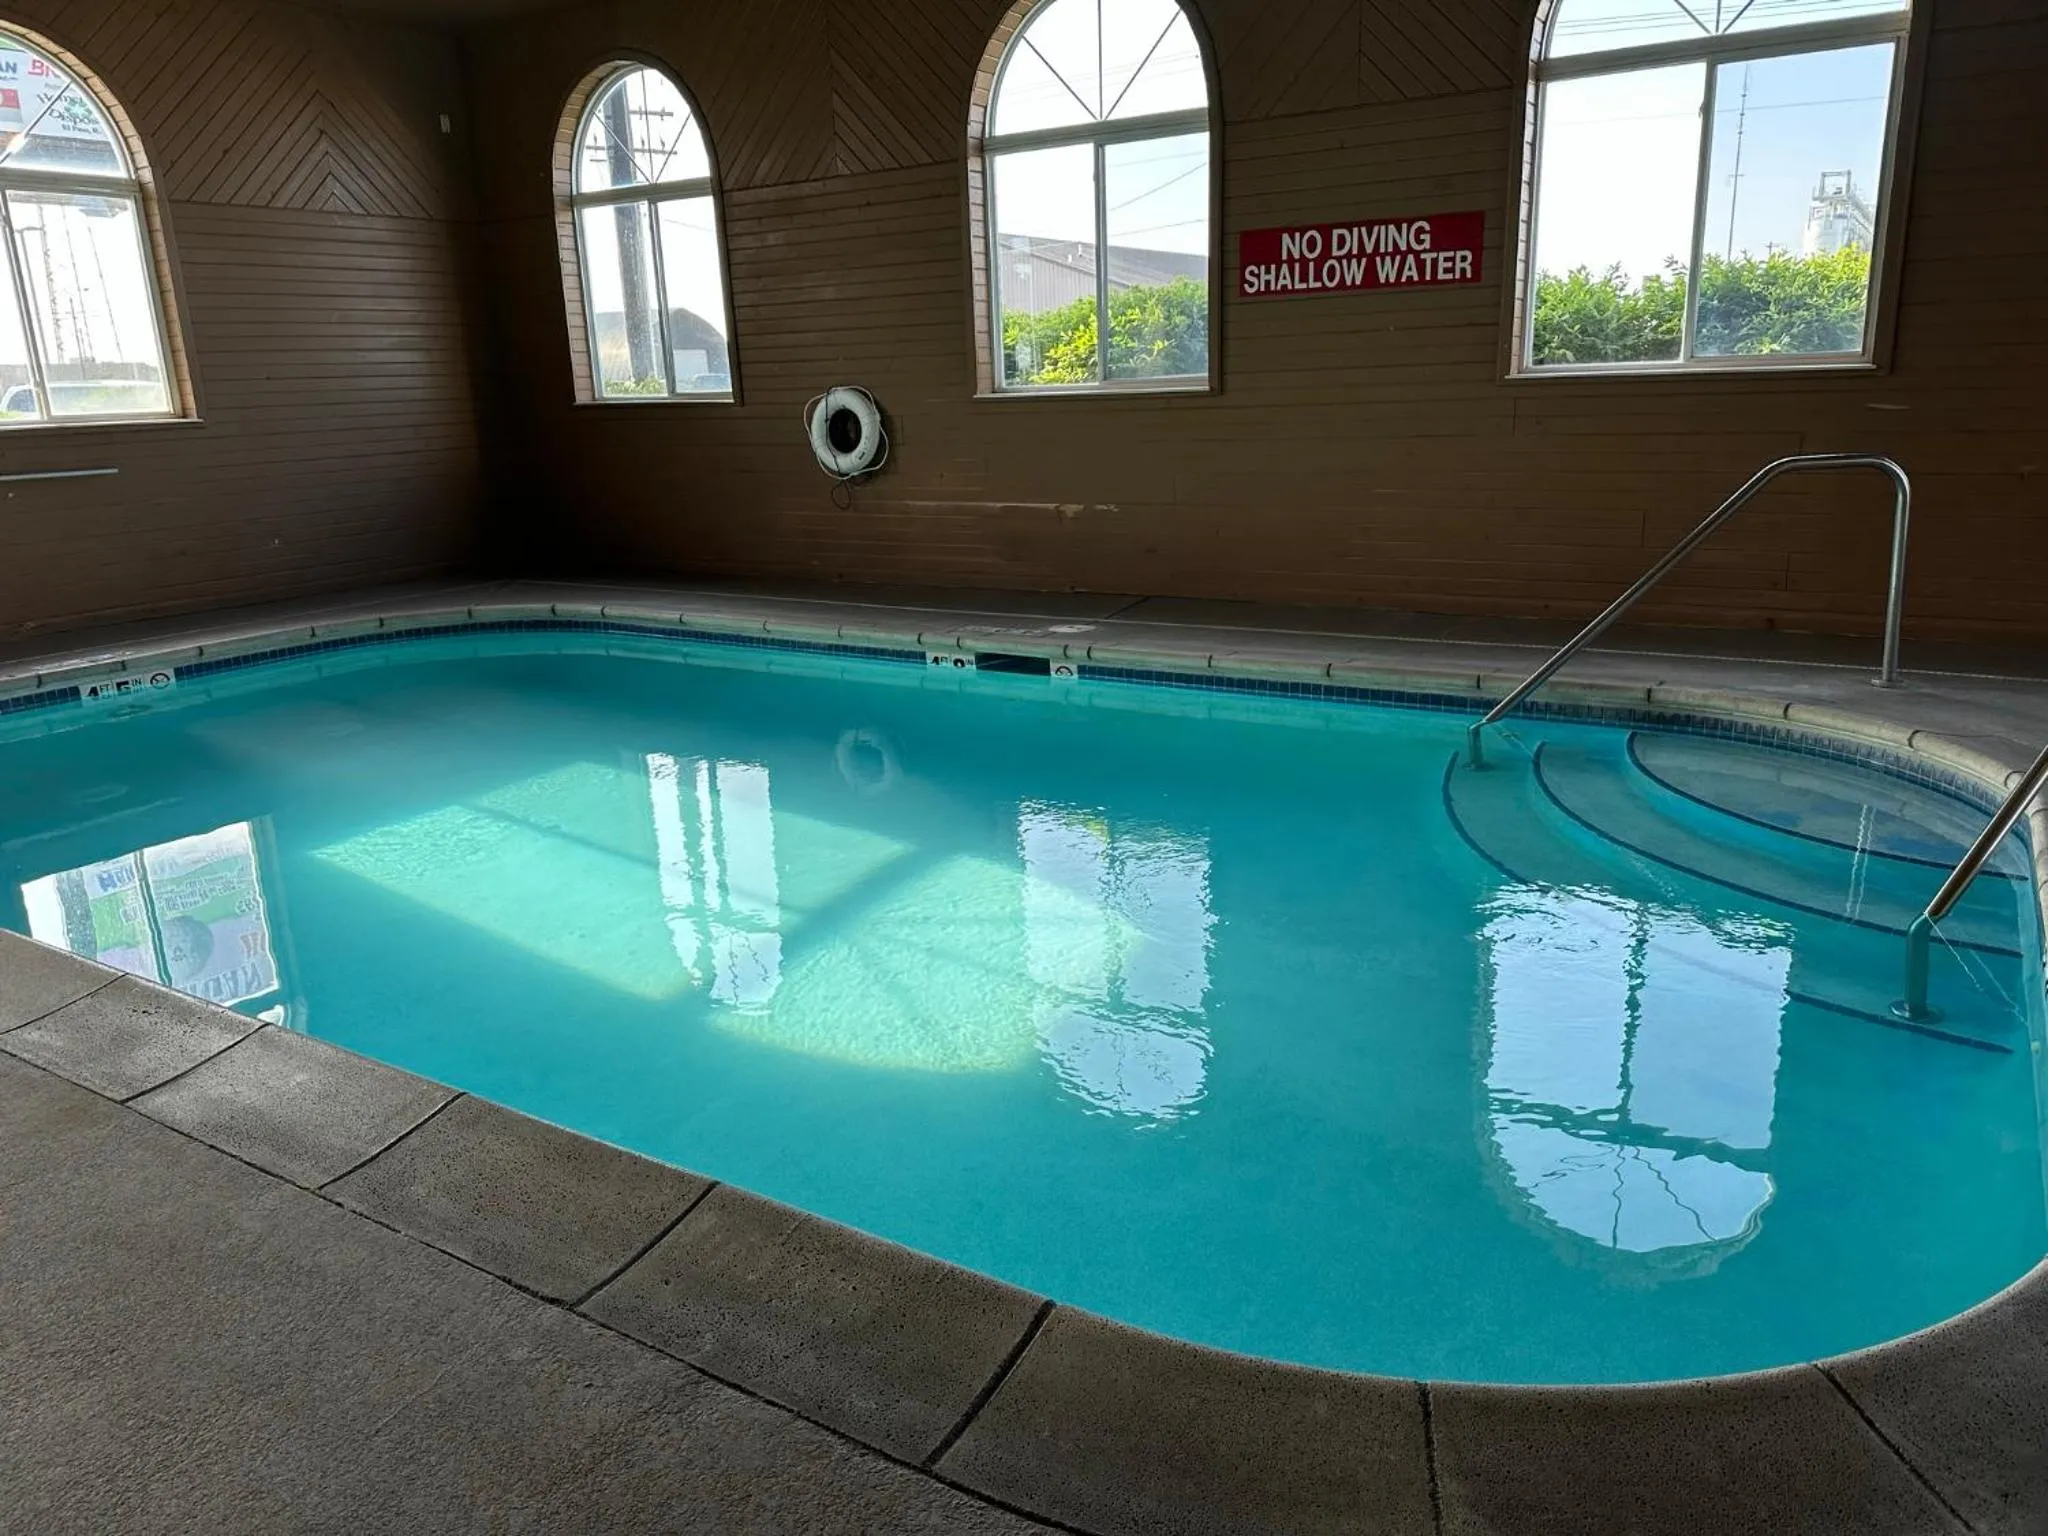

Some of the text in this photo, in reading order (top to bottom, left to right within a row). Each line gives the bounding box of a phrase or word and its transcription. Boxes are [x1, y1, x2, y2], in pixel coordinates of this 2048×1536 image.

[1281, 221, 1431, 260] NO DIVING
[1243, 250, 1473, 294] SHALLOW WATER
